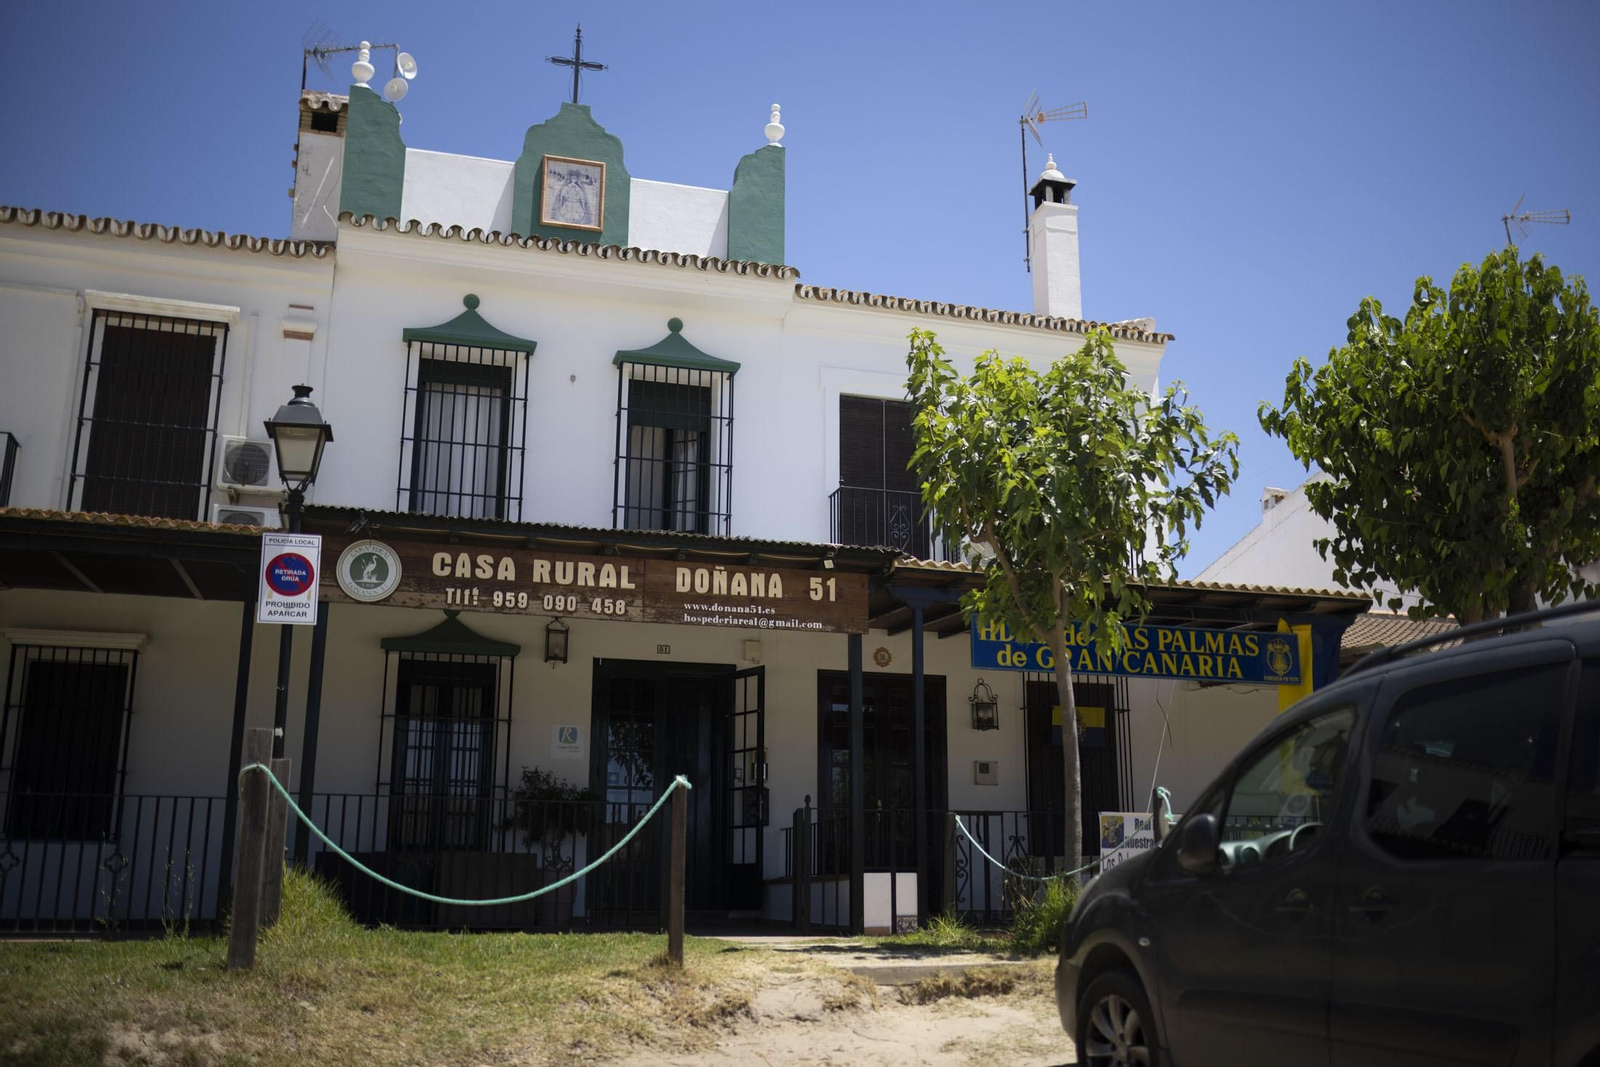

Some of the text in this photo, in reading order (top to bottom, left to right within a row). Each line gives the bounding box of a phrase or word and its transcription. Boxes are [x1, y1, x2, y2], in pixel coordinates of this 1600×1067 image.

[275, 568, 307, 576] RETIRADA
[432, 552, 836, 602] CASA RURAL DOÑANA 51
[265, 601, 311, 609] PROHIBIDO
[493, 590, 528, 609] 959
[543, 594, 577, 612] 090
[591, 597, 626, 615] 458
[684, 602, 776, 615] www.donana51.es
[267, 610, 308, 618] APARCAR
[684, 612, 823, 630] hospederiareal@gmail.com
[1158, 628, 1260, 657] PALMAS
[996, 644, 1028, 667] de
[1122, 651, 1244, 679] CANARIA
